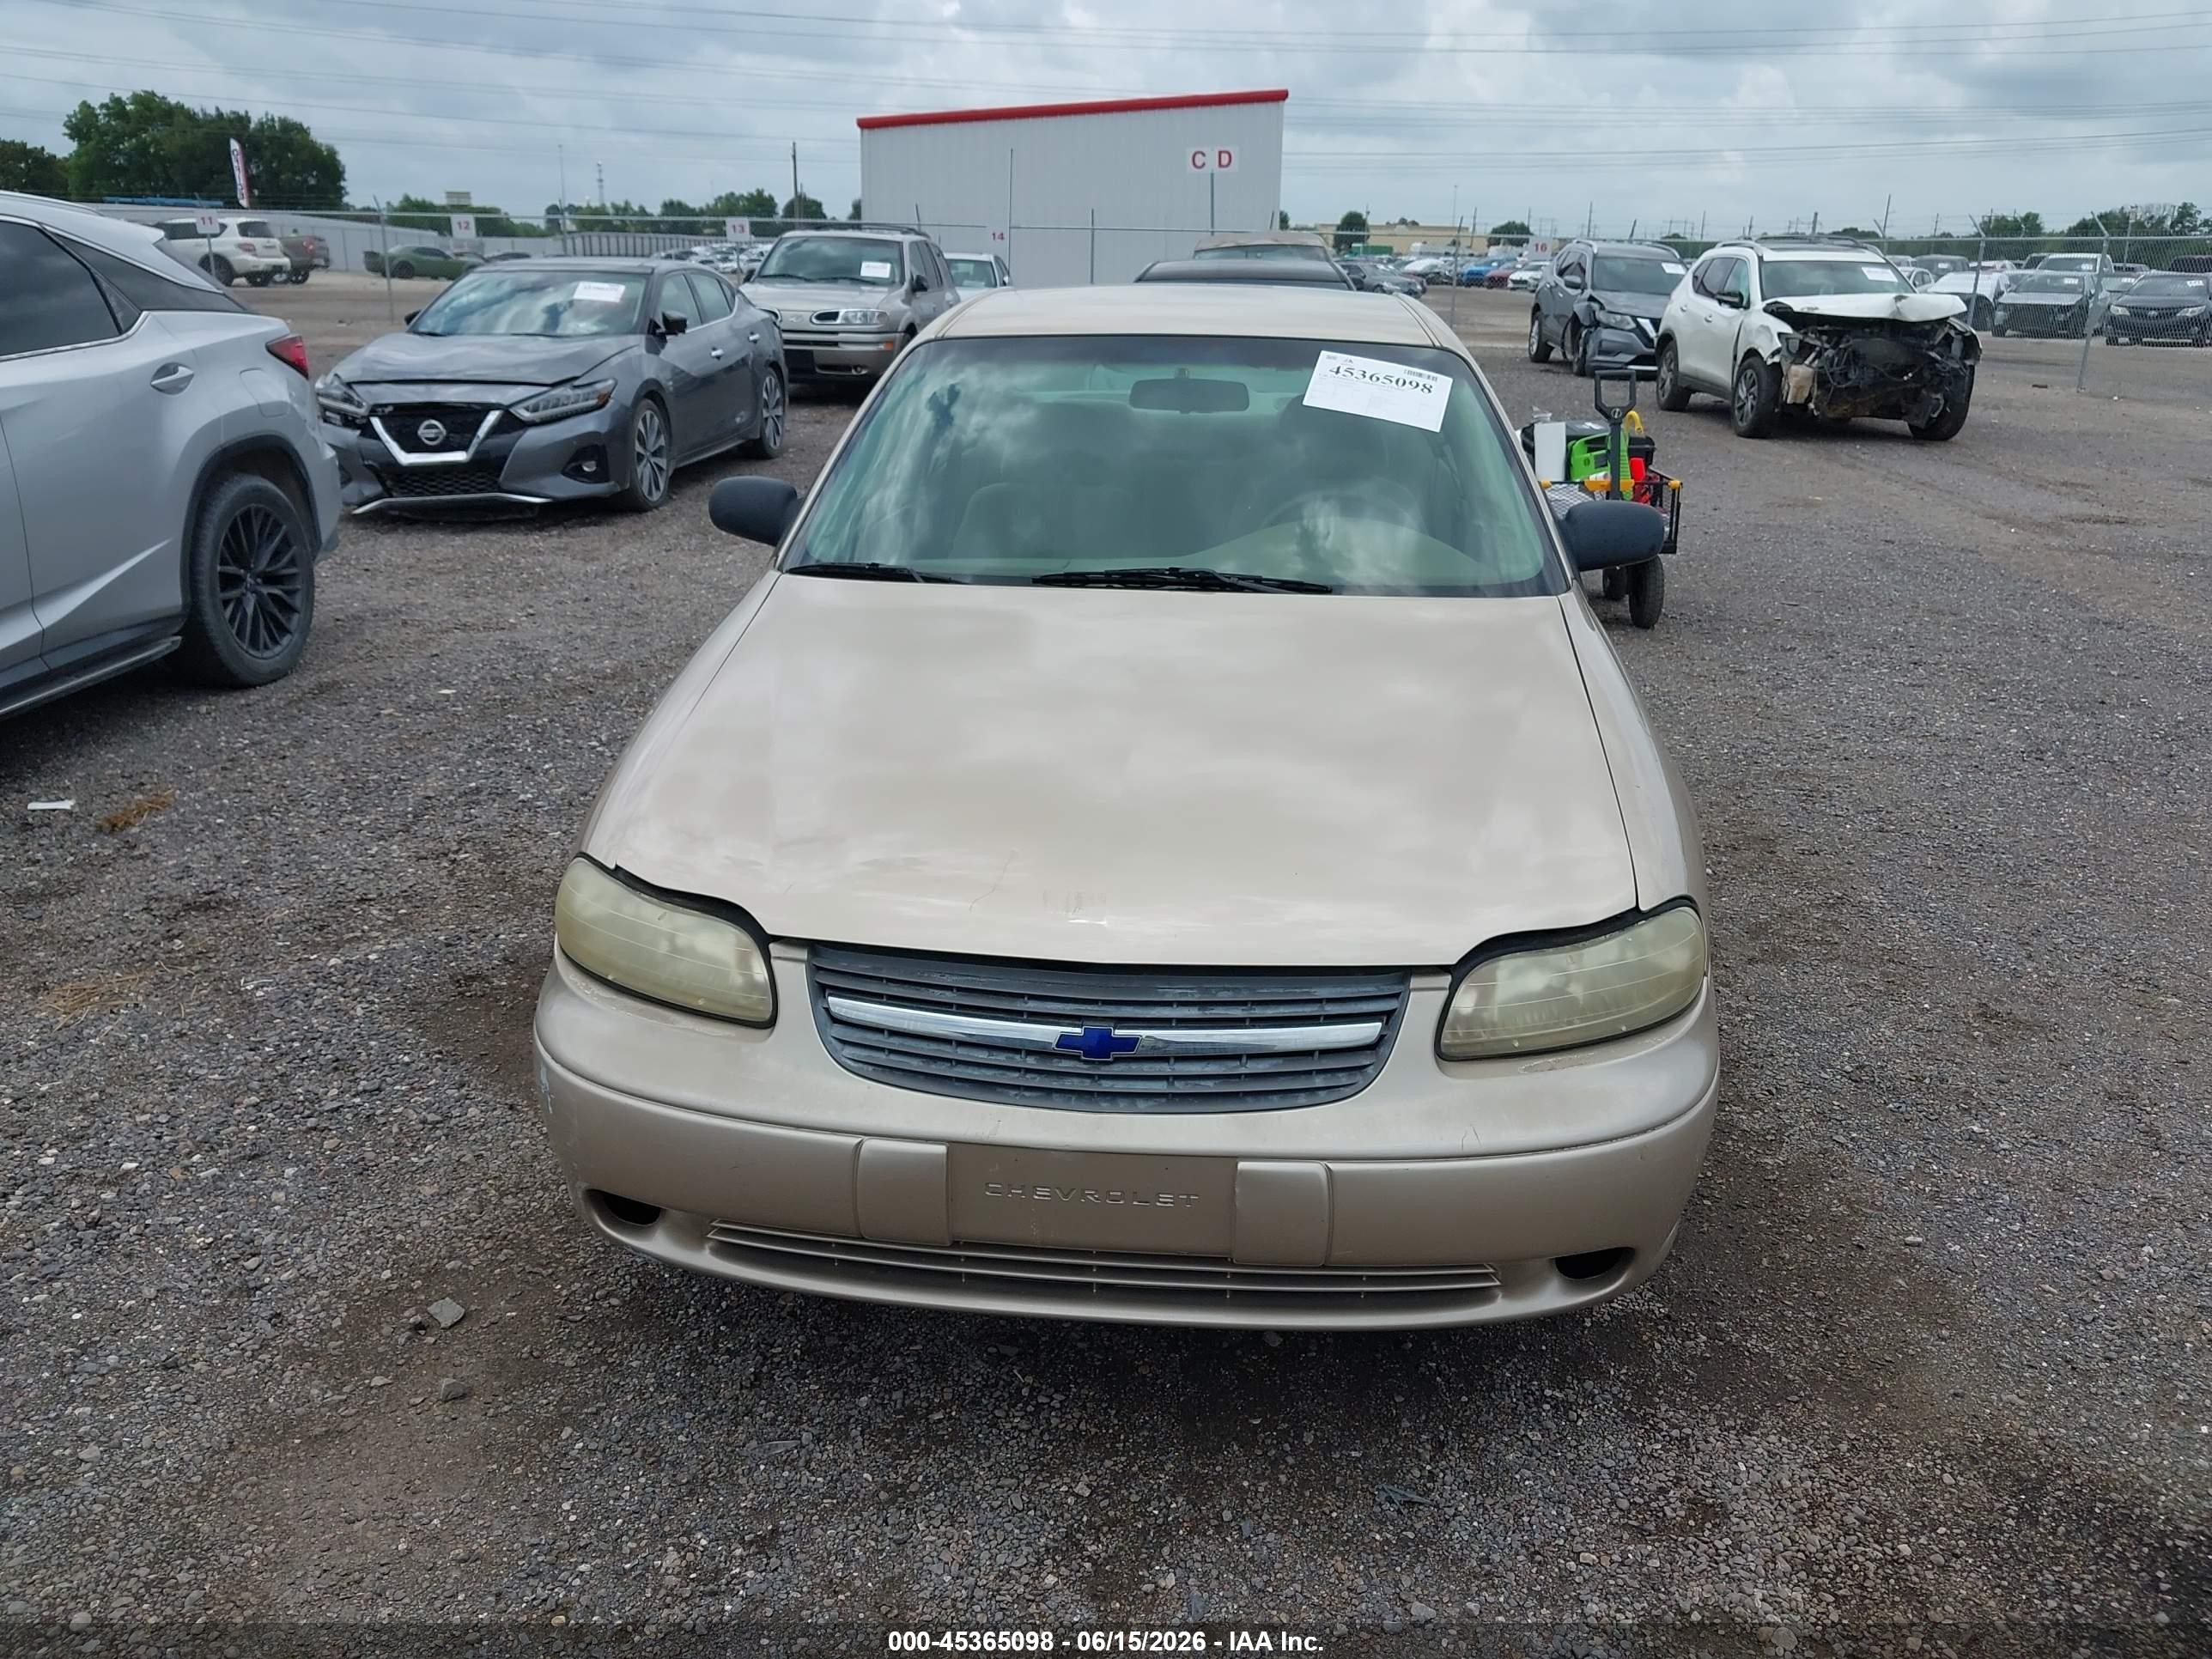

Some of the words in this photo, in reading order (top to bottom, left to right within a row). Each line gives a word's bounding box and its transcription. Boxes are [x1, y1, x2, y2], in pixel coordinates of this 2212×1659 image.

[1192, 150, 1206, 169] C
[1218, 150, 1232, 168] D
[200, 216, 213, 226] 11
[457, 220, 470, 230] 12
[992, 232, 1005, 240] 14
[1534, 243, 1547, 252] 16
[1328, 365, 1433, 394] 45365098
[985, 1182, 1200, 1208] CHEVROLET
